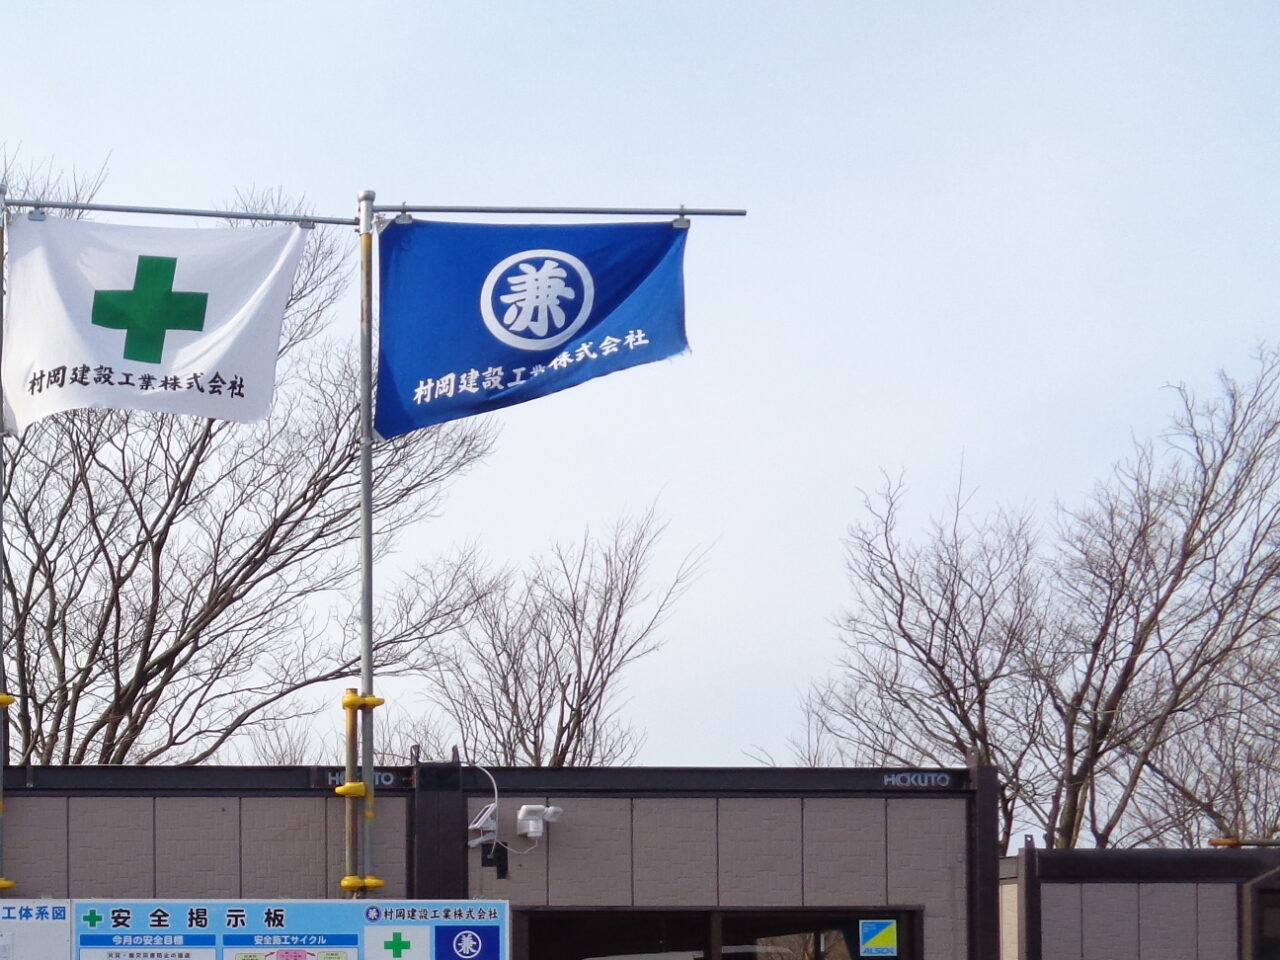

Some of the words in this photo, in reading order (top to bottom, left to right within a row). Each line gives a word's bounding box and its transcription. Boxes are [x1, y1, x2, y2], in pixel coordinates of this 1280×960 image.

[28, 363, 245, 398] 村岡建設工業株式会社
[884, 772, 950, 787] HOKUTO
[111, 908, 285, 928] 安全掲示板
[383, 908, 498, 920] 村岡建設工業株式会社
[112, 935, 184, 945] 今月の安全目標
[254, 935, 327, 945] 安全施工サイクル
